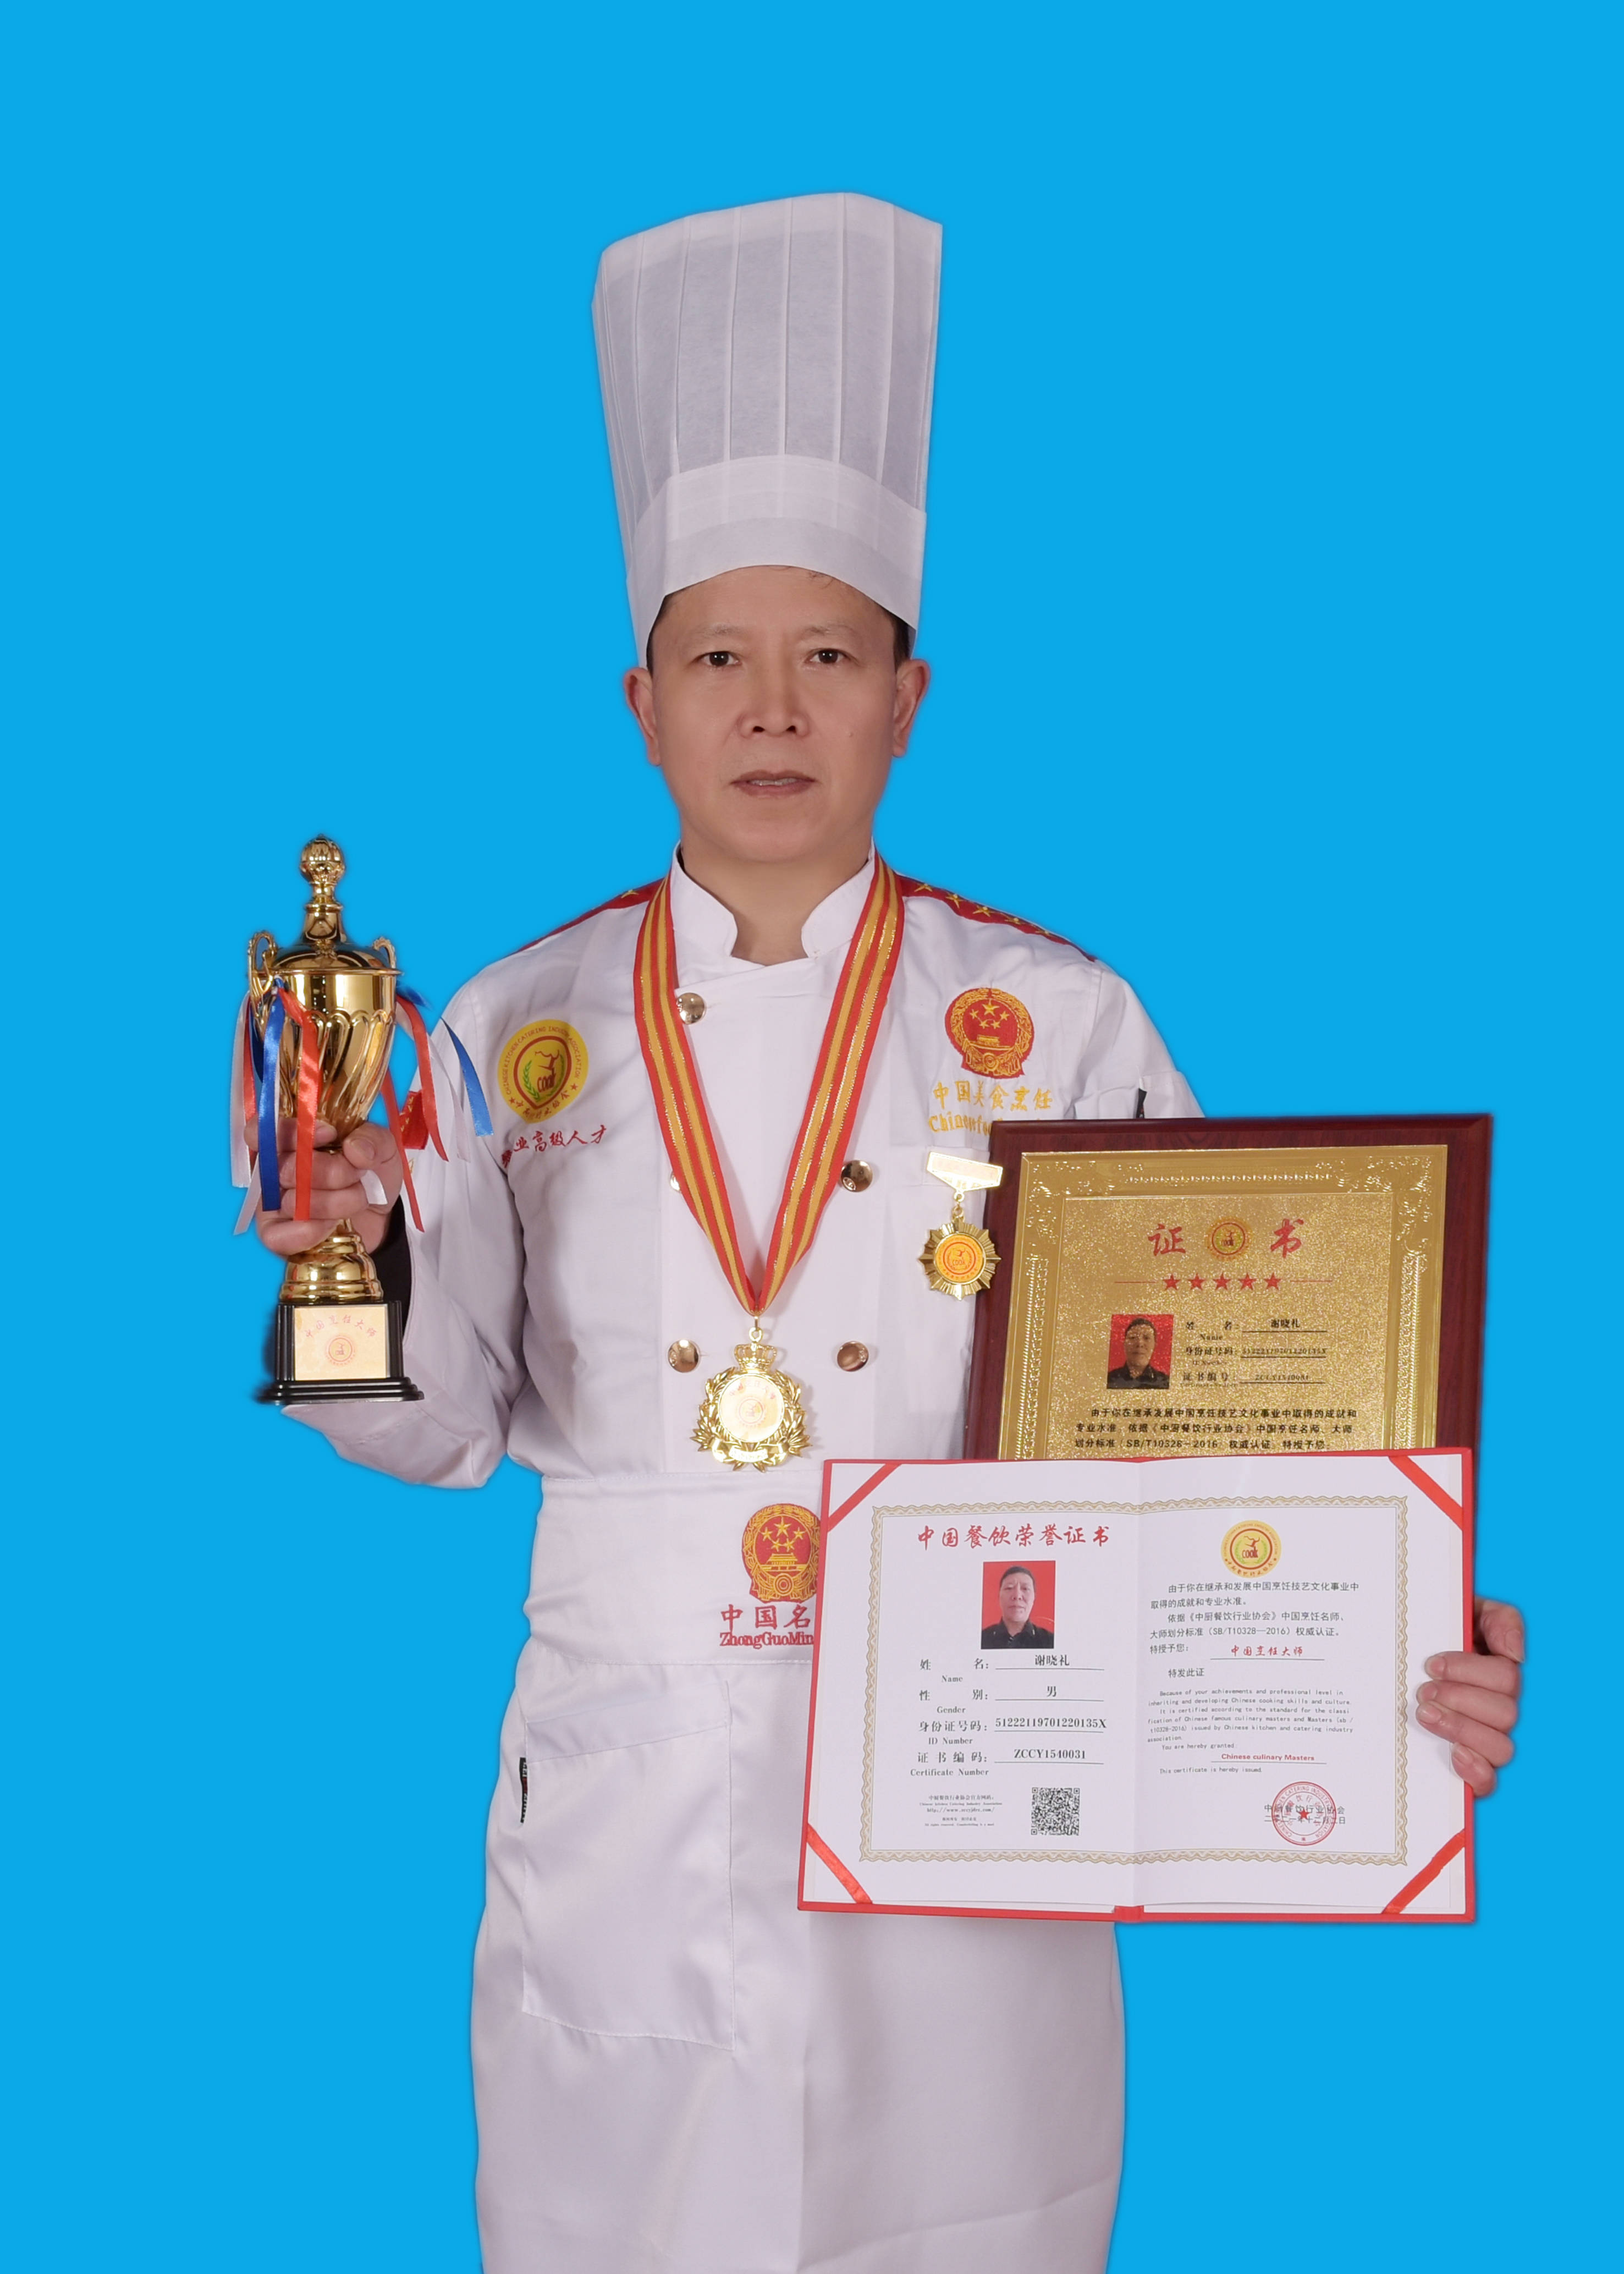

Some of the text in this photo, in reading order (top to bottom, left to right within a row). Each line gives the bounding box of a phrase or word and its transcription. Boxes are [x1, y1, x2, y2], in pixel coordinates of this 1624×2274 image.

[1148, 1218, 1304, 1258] 证 书
[918, 1523, 1110, 1551] 中国餐饮荣誉证书
[1168, 1581, 1359, 1594] 由于你在继承和发展中国烹饪技艺文化事业中
[720, 1604, 811, 1630] 中国名
[1231, 1644, 1303, 1657] 中国烹饪大师
[920, 1658, 931, 1671] 姓
[1034, 1654, 1070, 1667] 谢晓礼
[1168, 1667, 1205, 1678] 特发此证
[919, 1689, 931, 1701] 性
[1046, 1685, 1057, 1698] 男
[1148, 1698, 1179, 1706] inheriting
[937, 1706, 966, 1714] Gender
[995, 1717, 1107, 1729] 51222119701220135X
[942, 1737, 973, 1745] Number
[1014, 1749, 1086, 1760] ZCCY1540031
[910, 1768, 989, 1777] Certificate Number
